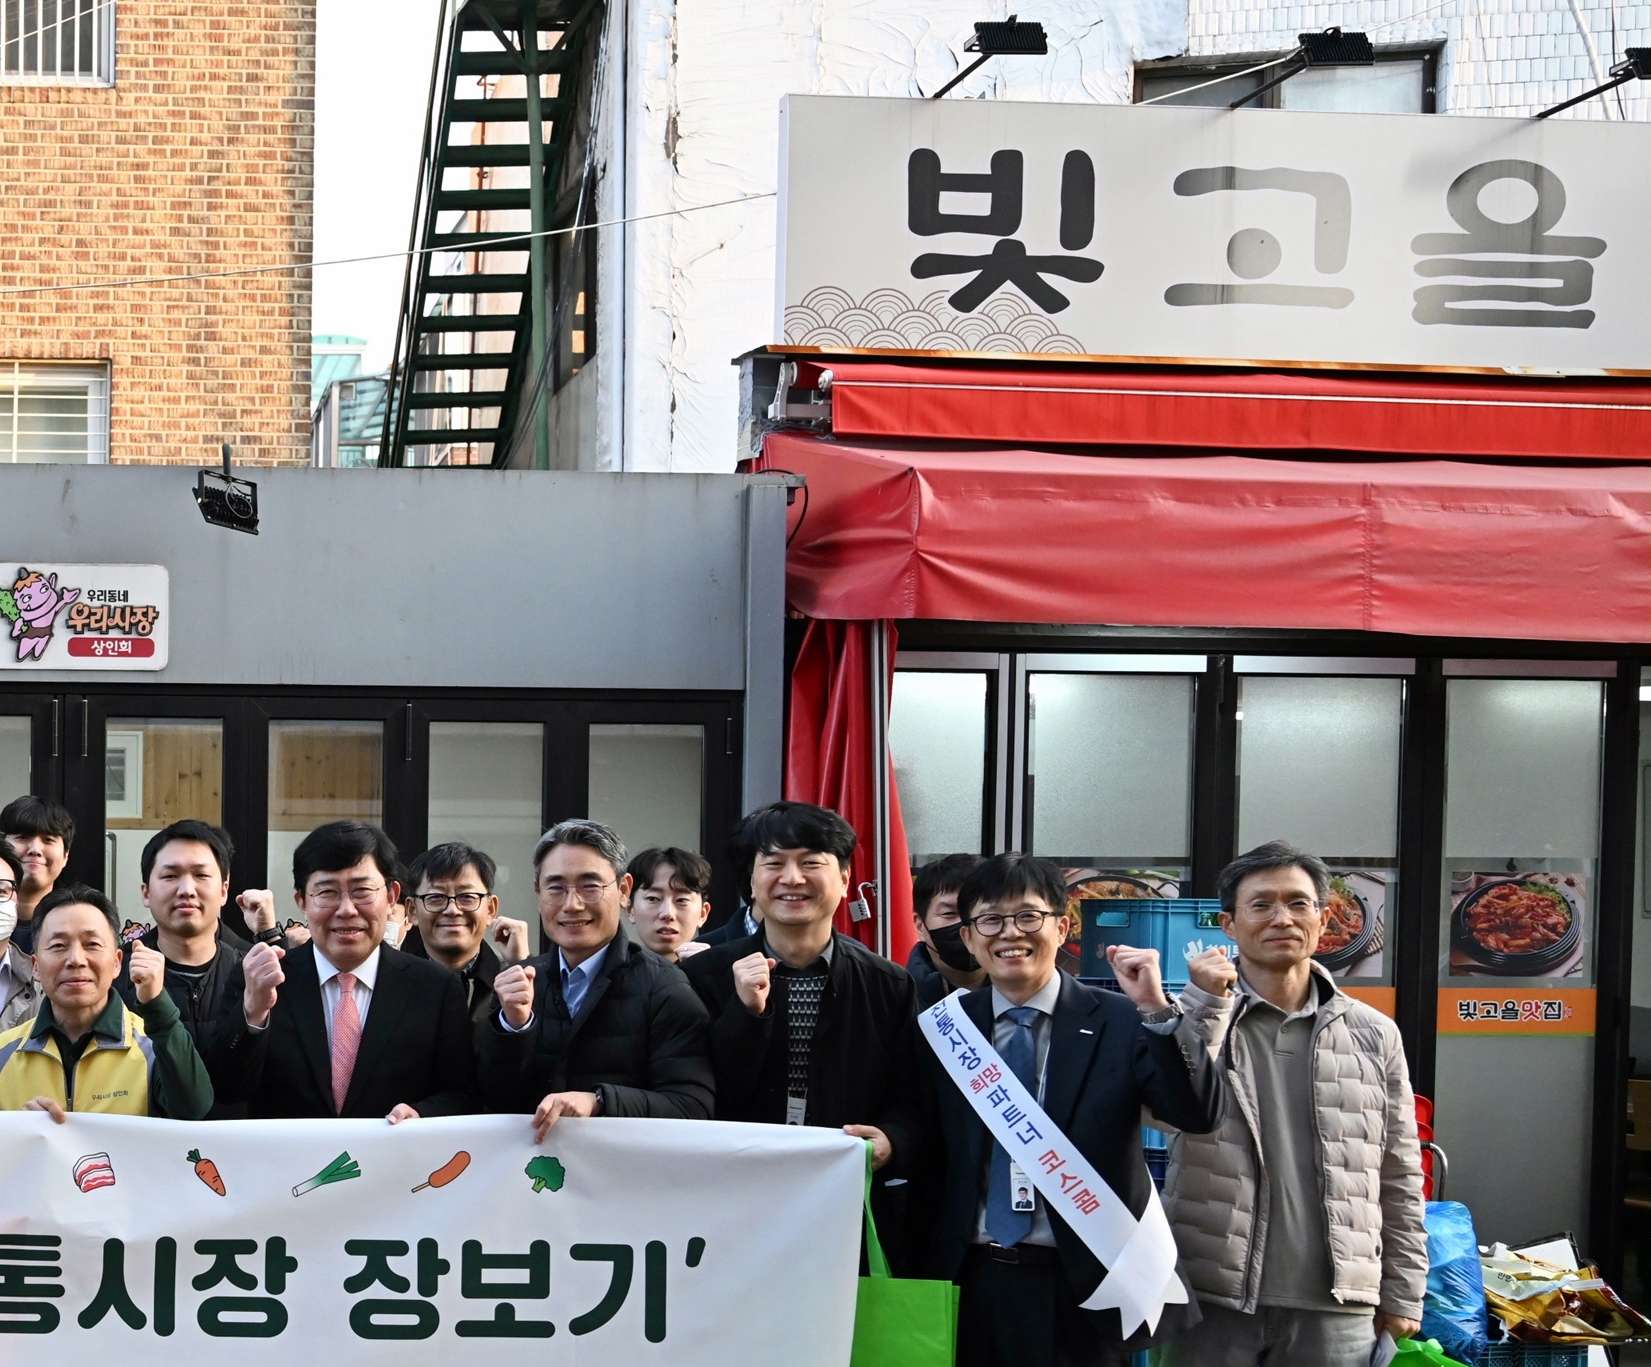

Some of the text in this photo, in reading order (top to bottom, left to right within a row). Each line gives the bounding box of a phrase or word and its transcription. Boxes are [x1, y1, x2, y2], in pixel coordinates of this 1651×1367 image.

[907, 146, 1608, 329] 빛고을
[87, 589, 129, 603] 우리동네
[66, 602, 159, 636] 우리시장
[91, 640, 132, 656] 상인회
[1458, 1000, 1562, 1021] 빛고을맛집
[931, 1000, 1101, 1215] 전통시장 희망 파트너 코스콤
